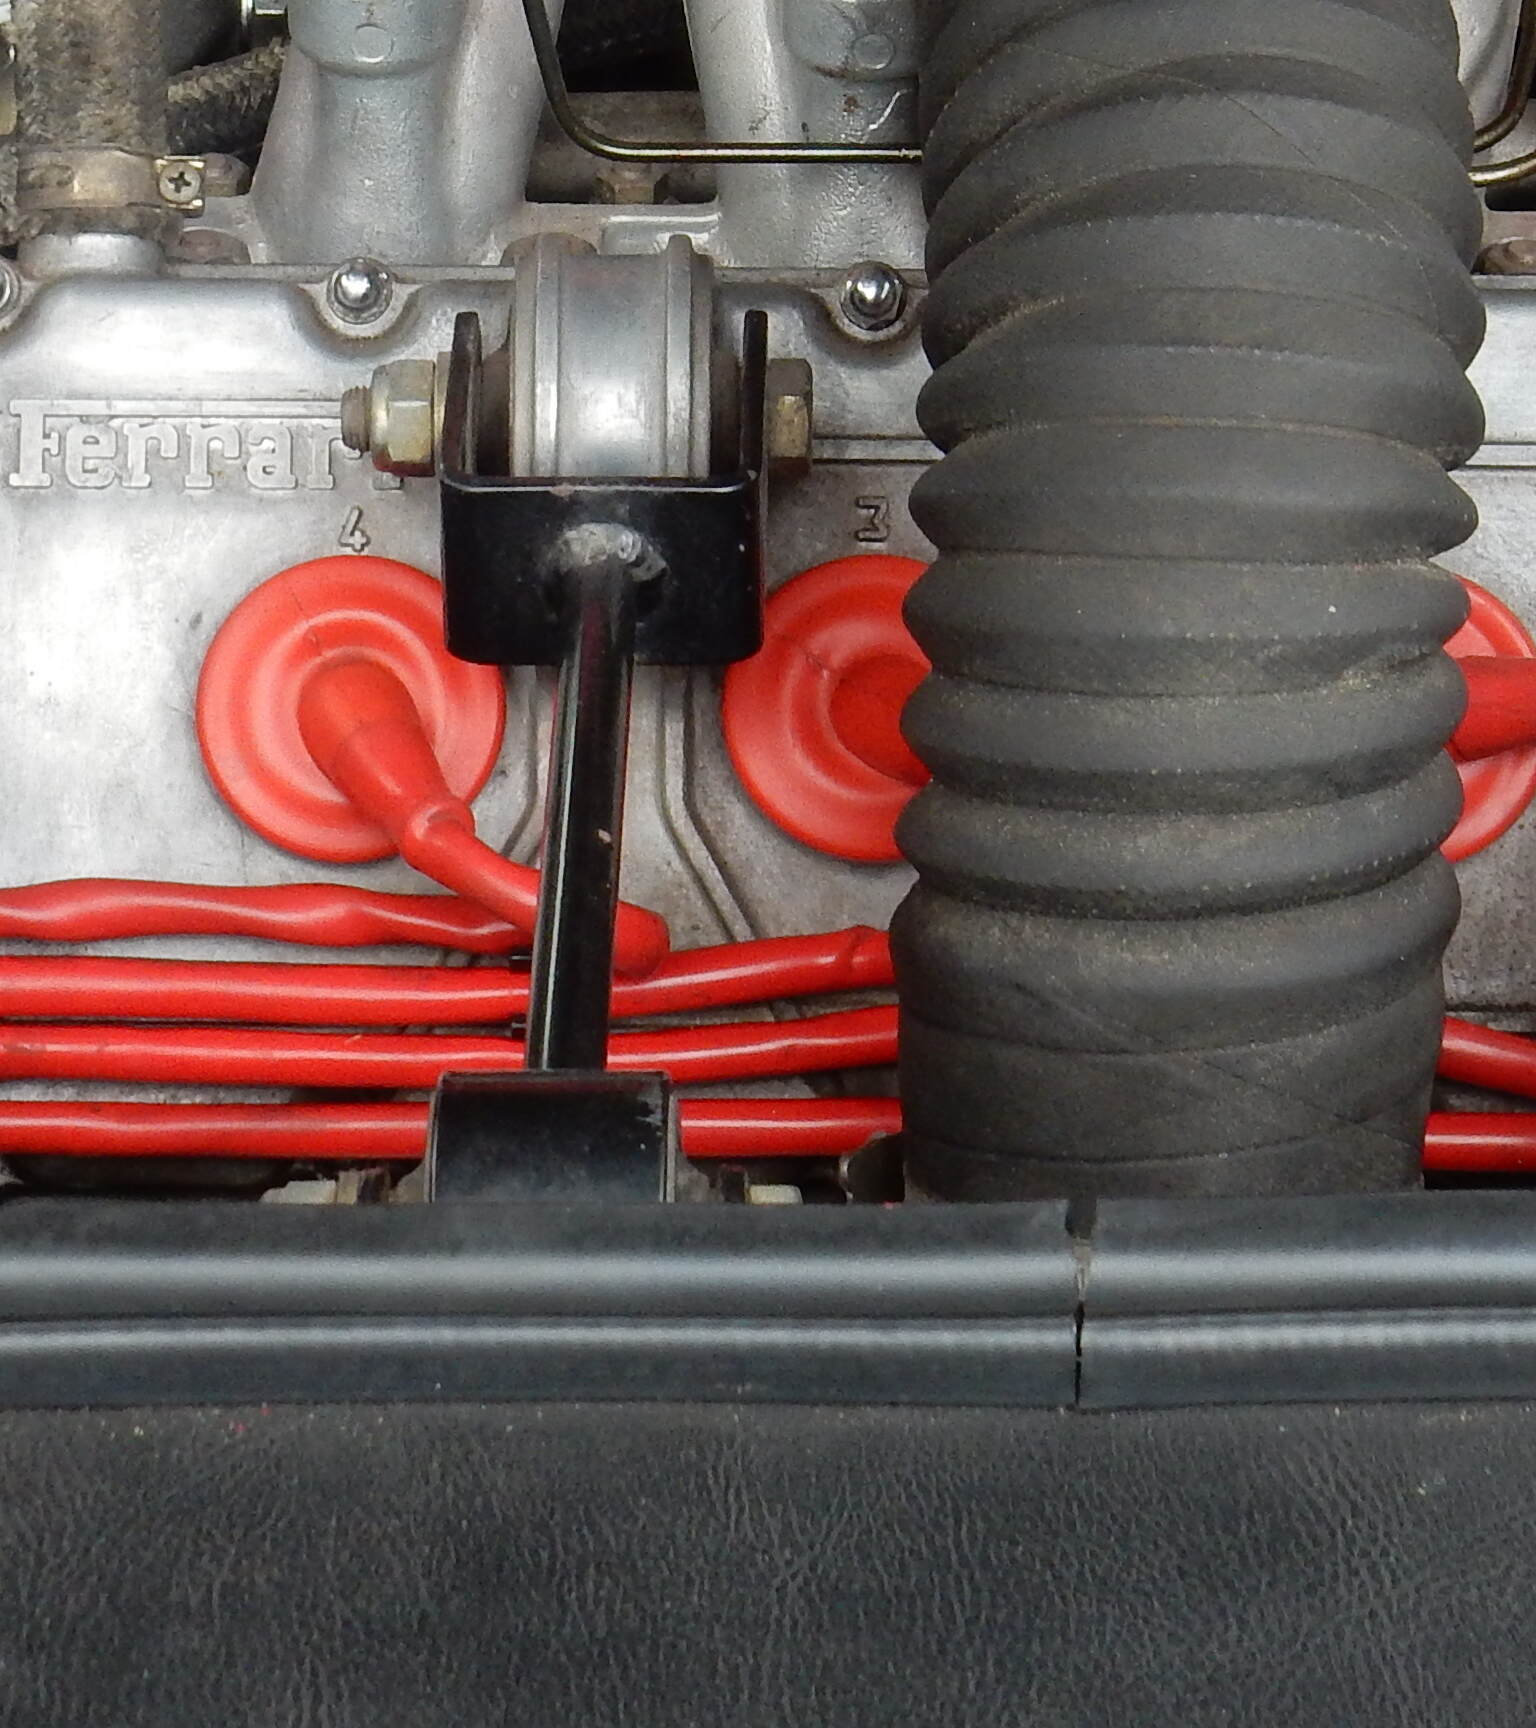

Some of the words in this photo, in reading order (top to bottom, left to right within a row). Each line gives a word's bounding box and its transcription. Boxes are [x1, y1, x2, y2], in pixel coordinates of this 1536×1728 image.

[8, 398, 403, 490] Ferrar
[337, 505, 372, 554] 4
[854, 495, 890, 543] 3
